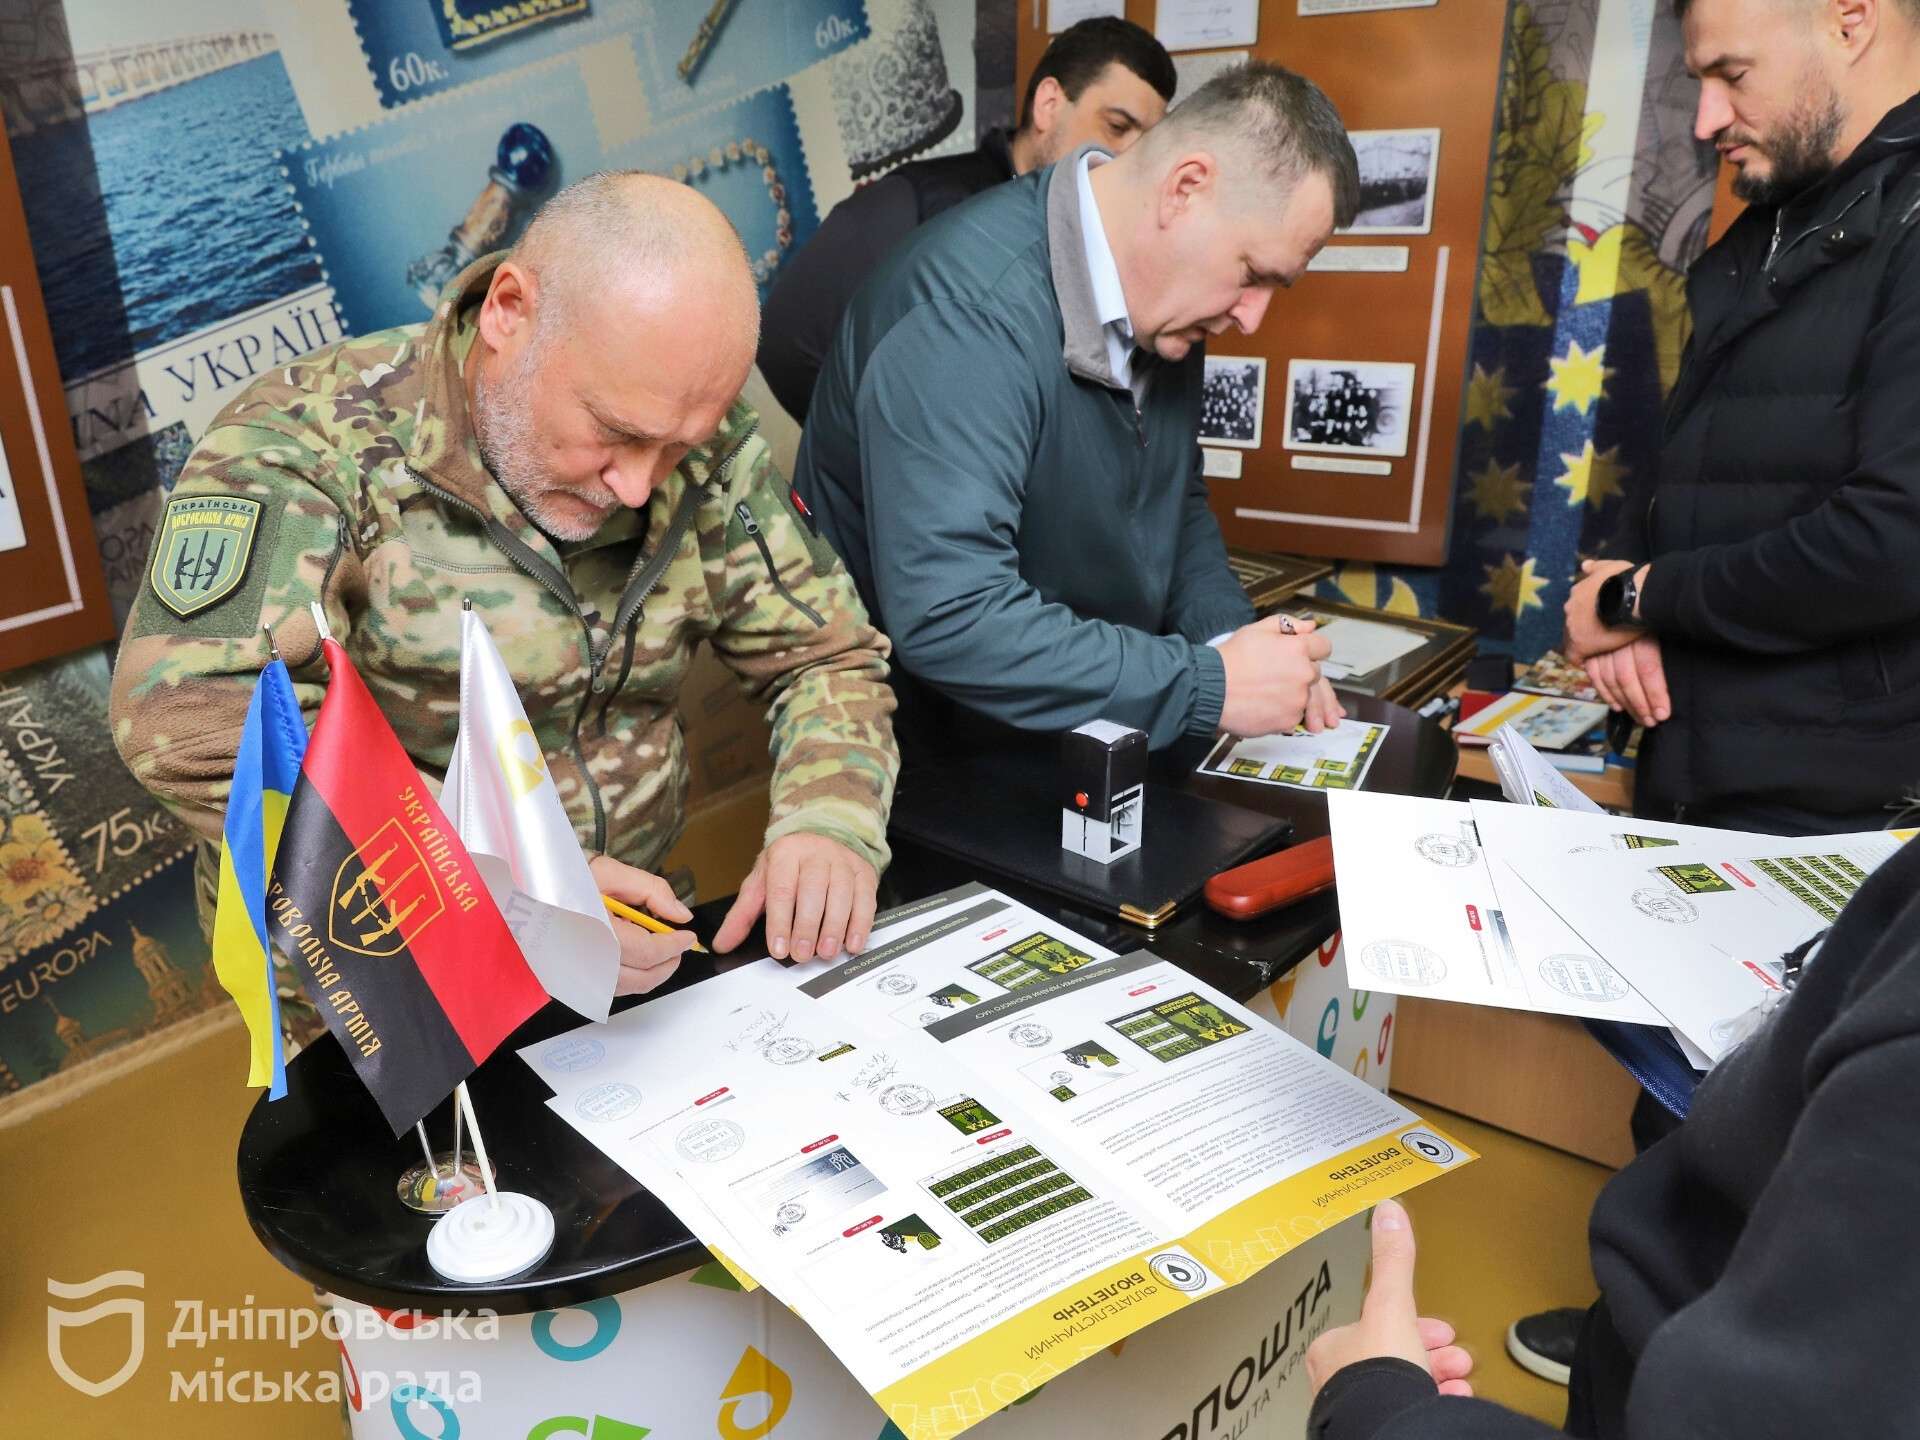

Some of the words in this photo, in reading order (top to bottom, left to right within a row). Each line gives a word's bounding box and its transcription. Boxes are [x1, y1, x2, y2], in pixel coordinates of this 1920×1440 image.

[172, 499, 255, 514] УКРАЇНСЬКА
[398, 786, 479, 912] УКРАЇНСЬКА
[268, 871, 341, 989] РОВОЛЬЧА
[328, 989, 383, 1058] АРМІЯ
[1312, 1157, 1414, 1209] ФІЛАТЕЛІСТИЧНИЙ
[1328, 1146, 1402, 1183] БЮЛЕТЕНЬ
[1025, 1286, 1158, 1360] ФІЛАТЕЛІСТИЧНИЙ
[1052, 1272, 1145, 1322] БЮЛЕТЕНЬ
